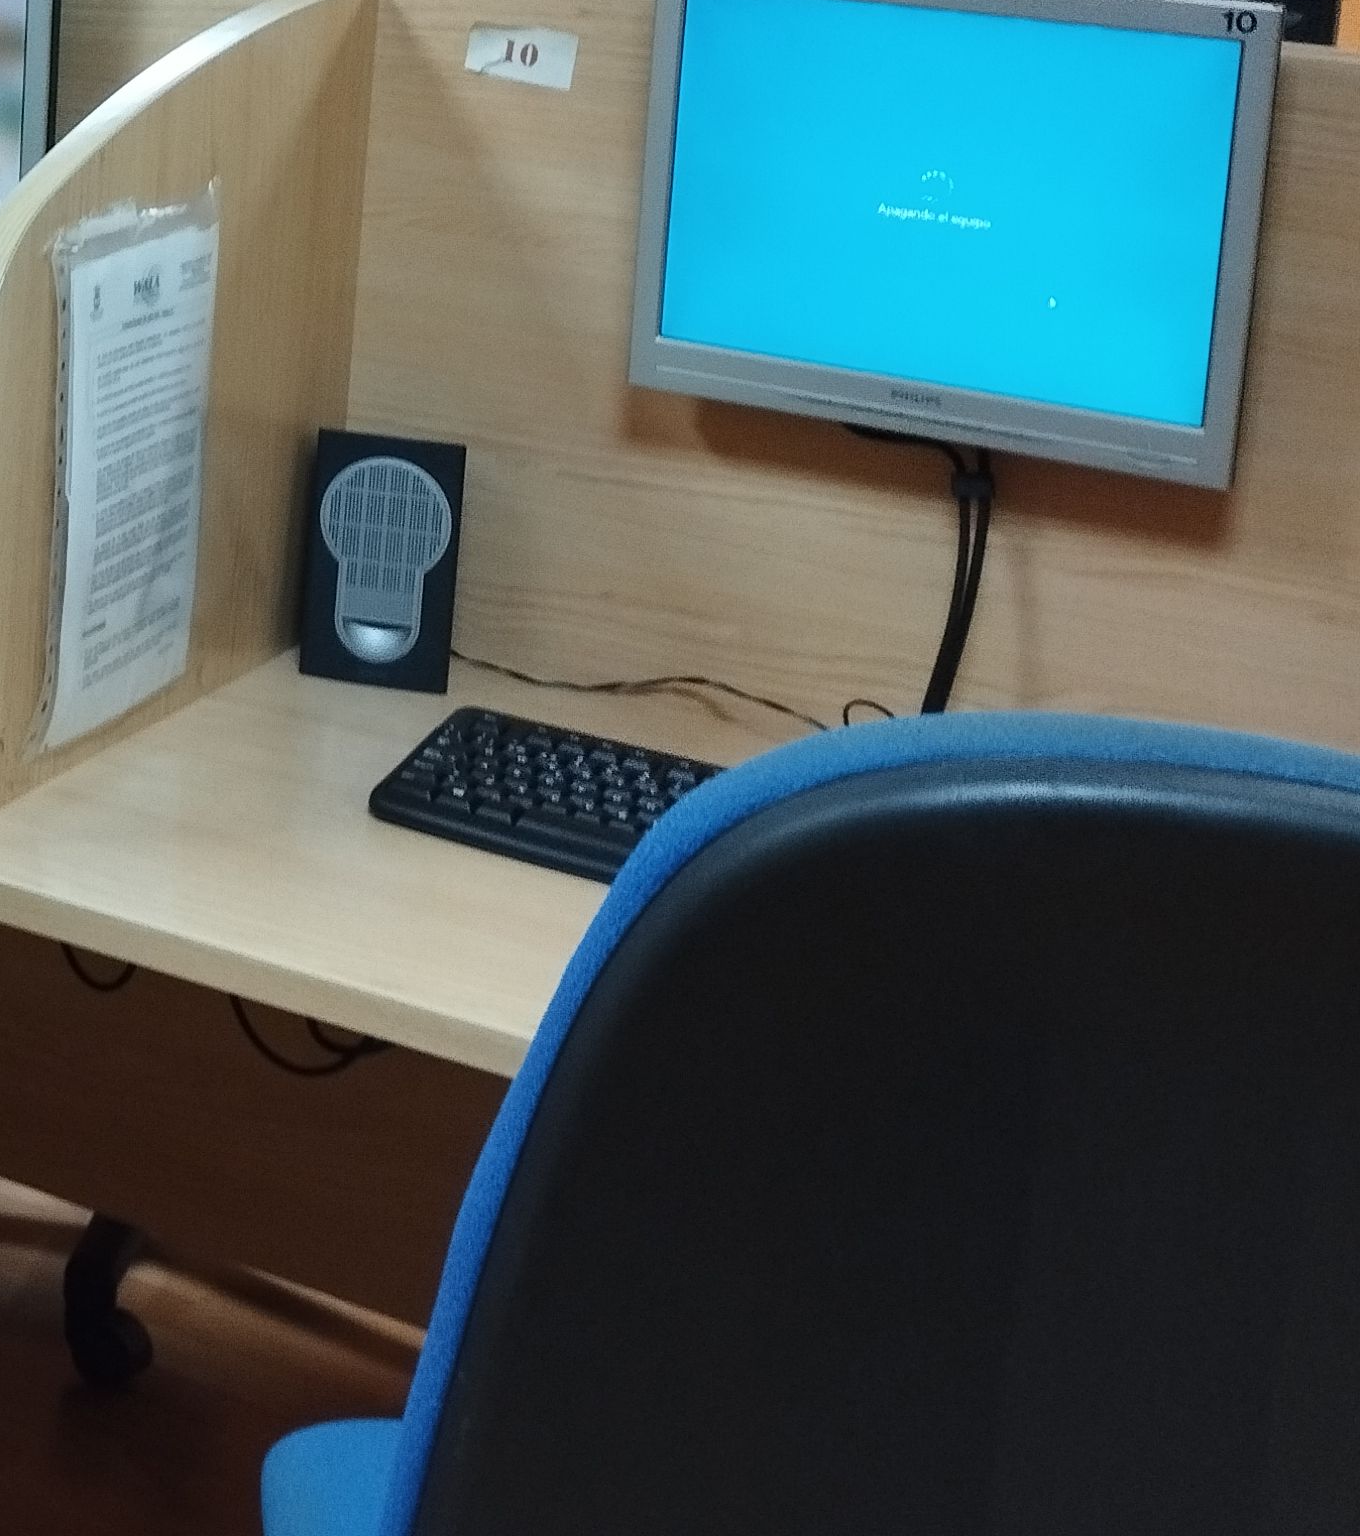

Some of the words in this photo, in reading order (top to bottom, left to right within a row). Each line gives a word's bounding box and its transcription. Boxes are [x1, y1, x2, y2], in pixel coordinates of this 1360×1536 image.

[1223, 8, 1259, 35] 10
[503, 37, 540, 68] 10
[877, 202, 936, 222] Apagando
[938, 211, 949, 224] el
[951, 215, 992, 230] equipo
